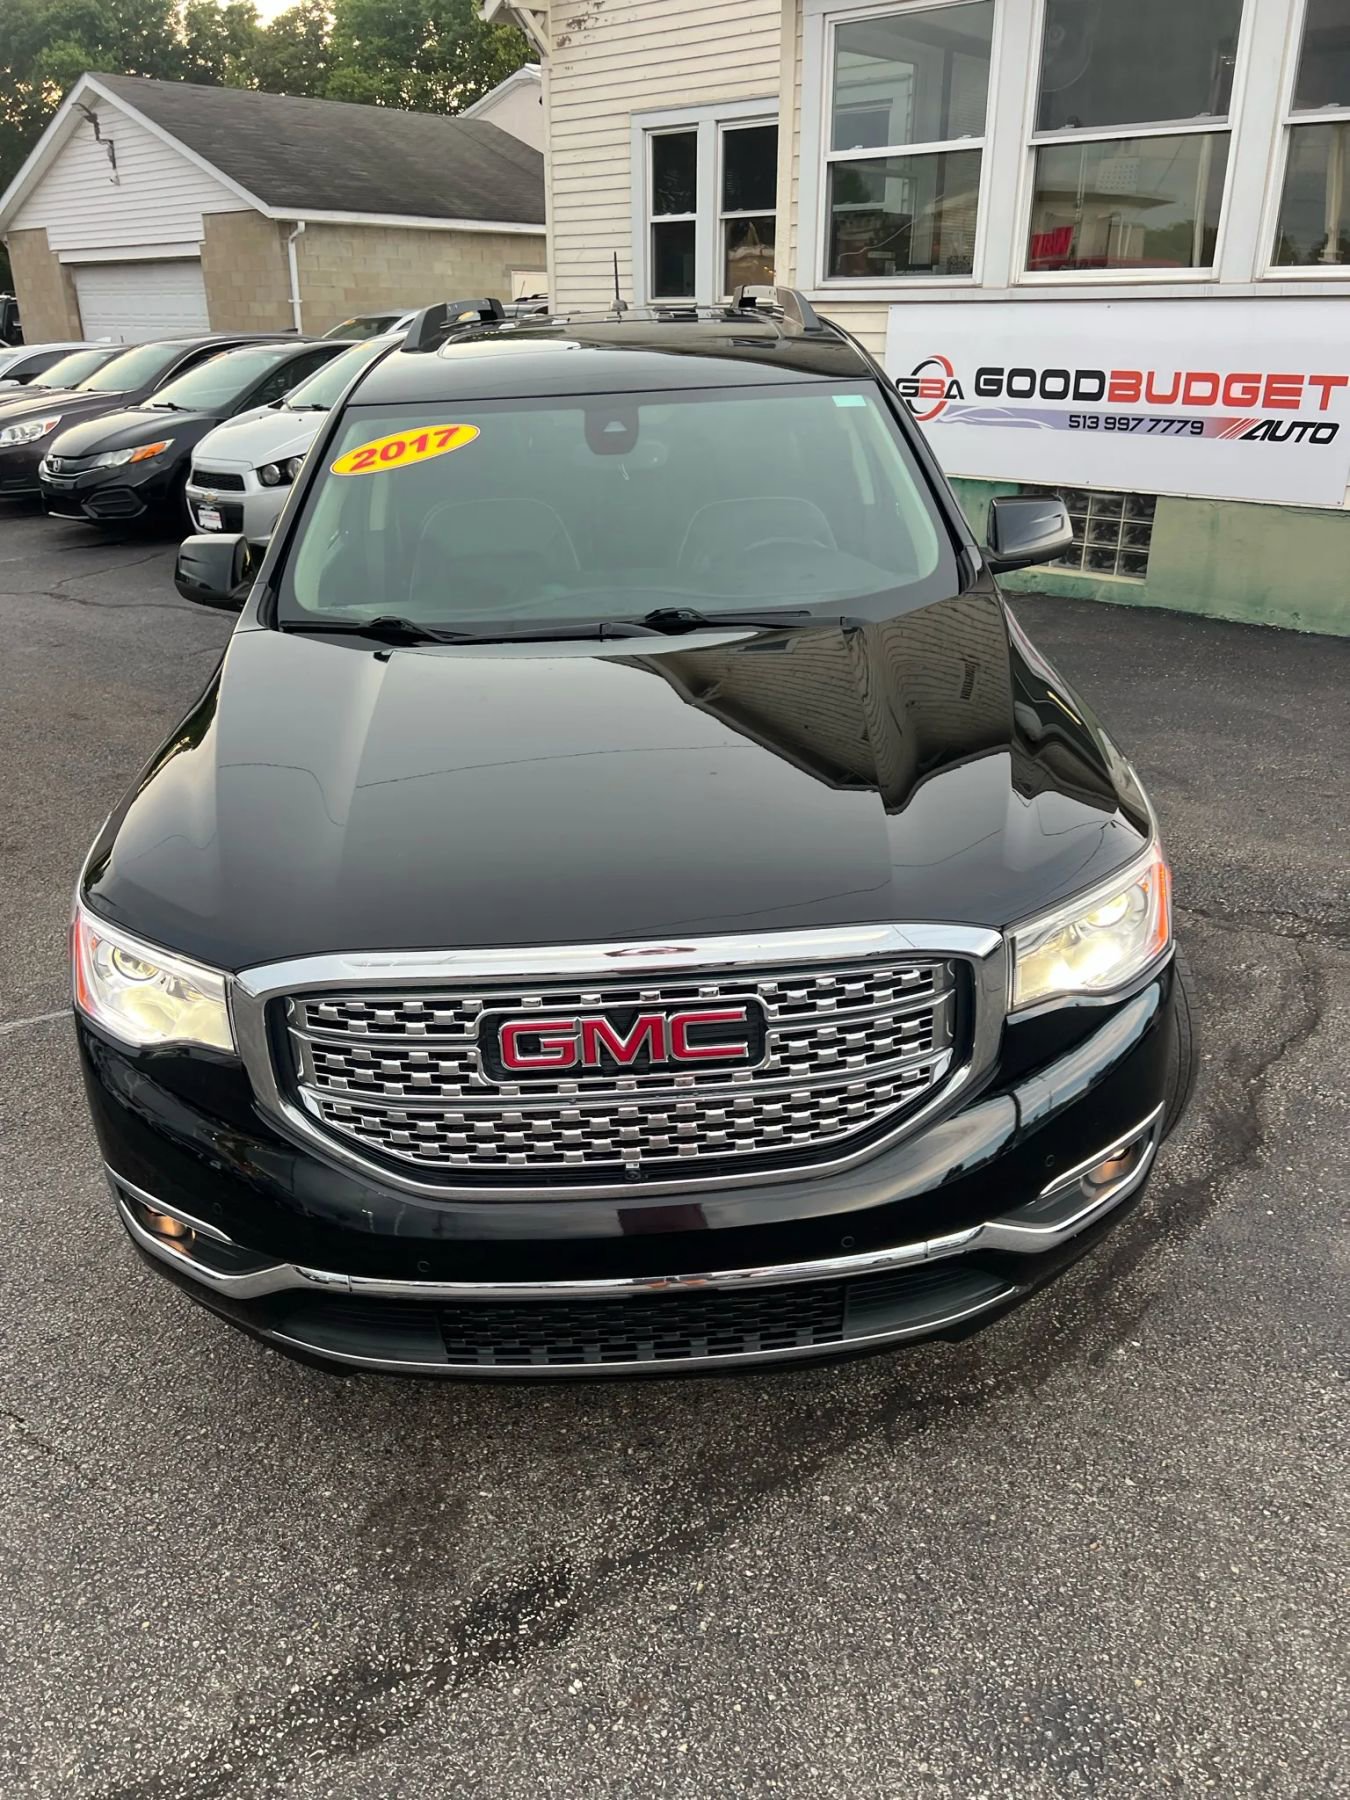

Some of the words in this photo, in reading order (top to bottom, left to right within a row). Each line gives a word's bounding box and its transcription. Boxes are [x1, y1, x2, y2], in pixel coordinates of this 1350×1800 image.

[895, 378, 965, 400] GBA
[1068, 414, 1099, 430] 513
[1103, 416, 1145, 432] 997
[1147, 418, 1205, 435] 7779
[1239, 419, 1340, 444] AUTO
[349, 426, 460, 472] 2017
[498, 1005, 748, 1071] GMC
